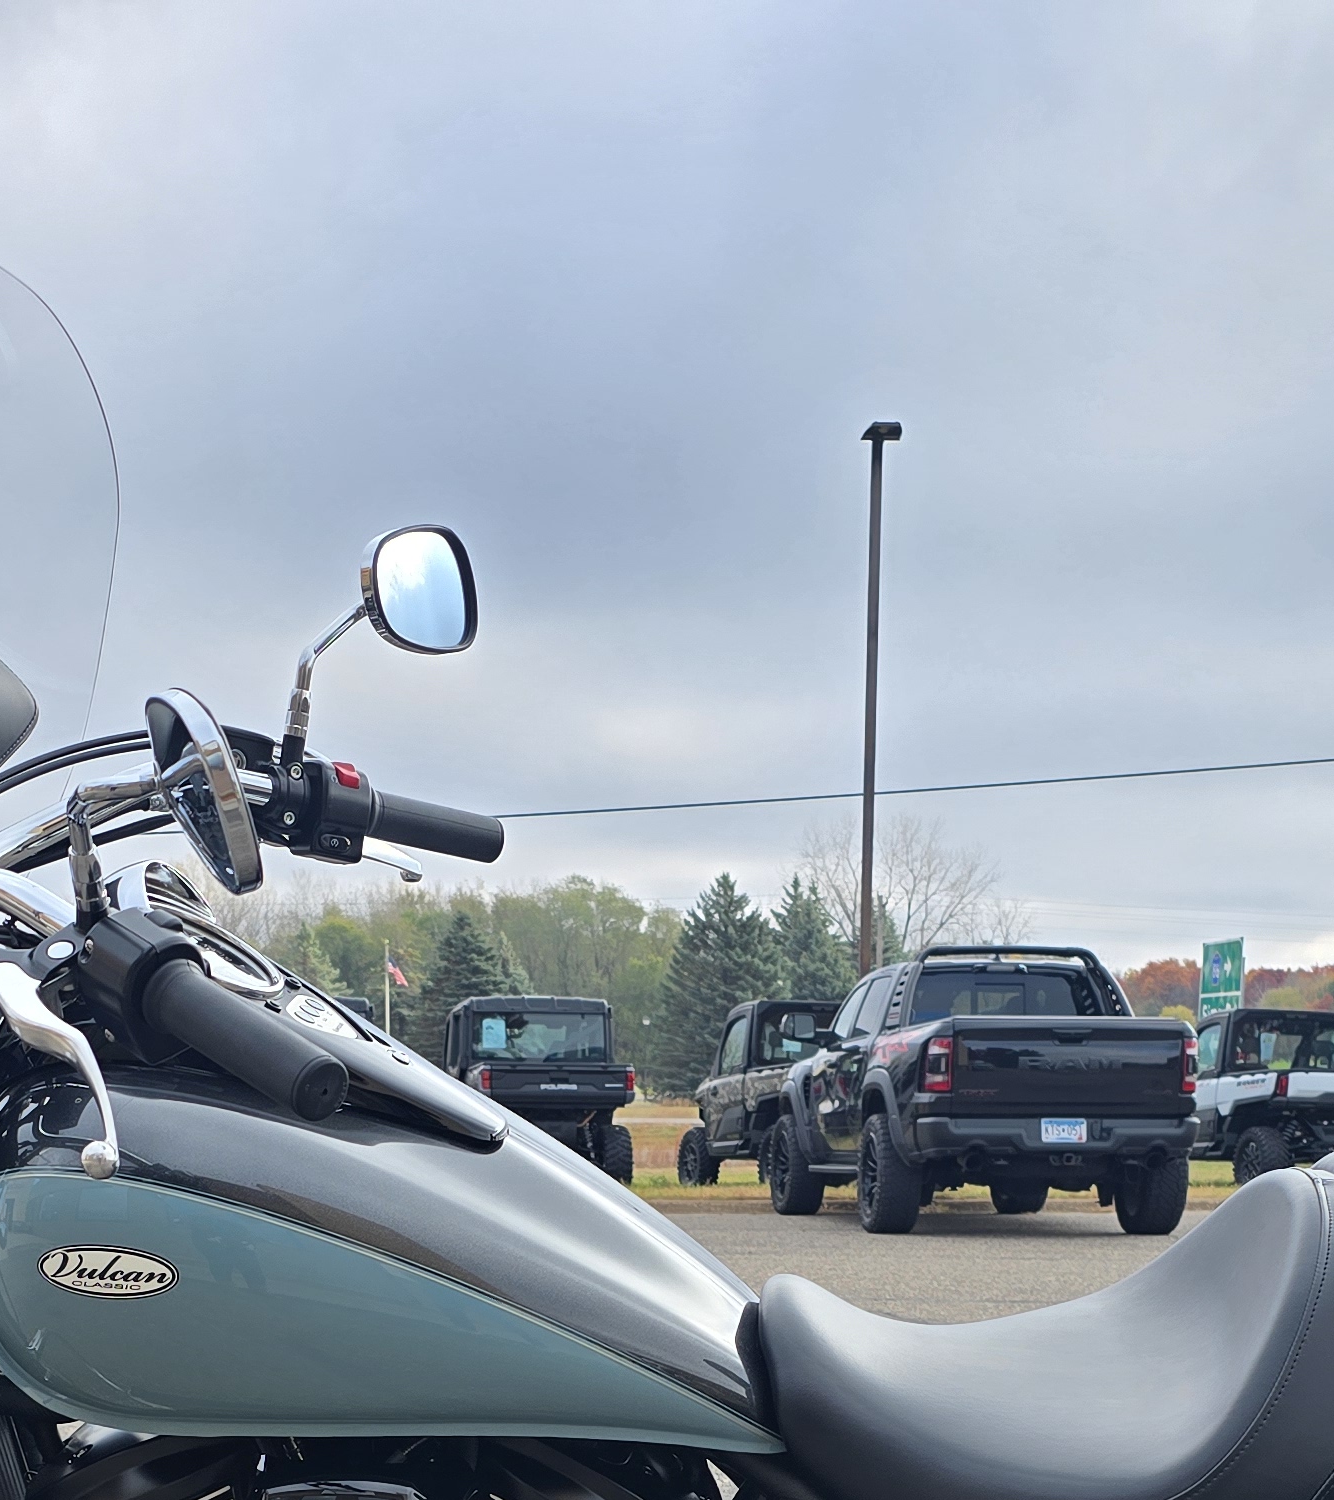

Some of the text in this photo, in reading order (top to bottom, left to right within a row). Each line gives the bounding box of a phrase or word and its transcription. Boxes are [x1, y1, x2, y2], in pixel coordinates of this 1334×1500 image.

[1018, 1056, 1122, 1070] RAM
[50, 1252, 170, 1283] Vulcan
[71, 1281, 141, 1291] CLASSIC
